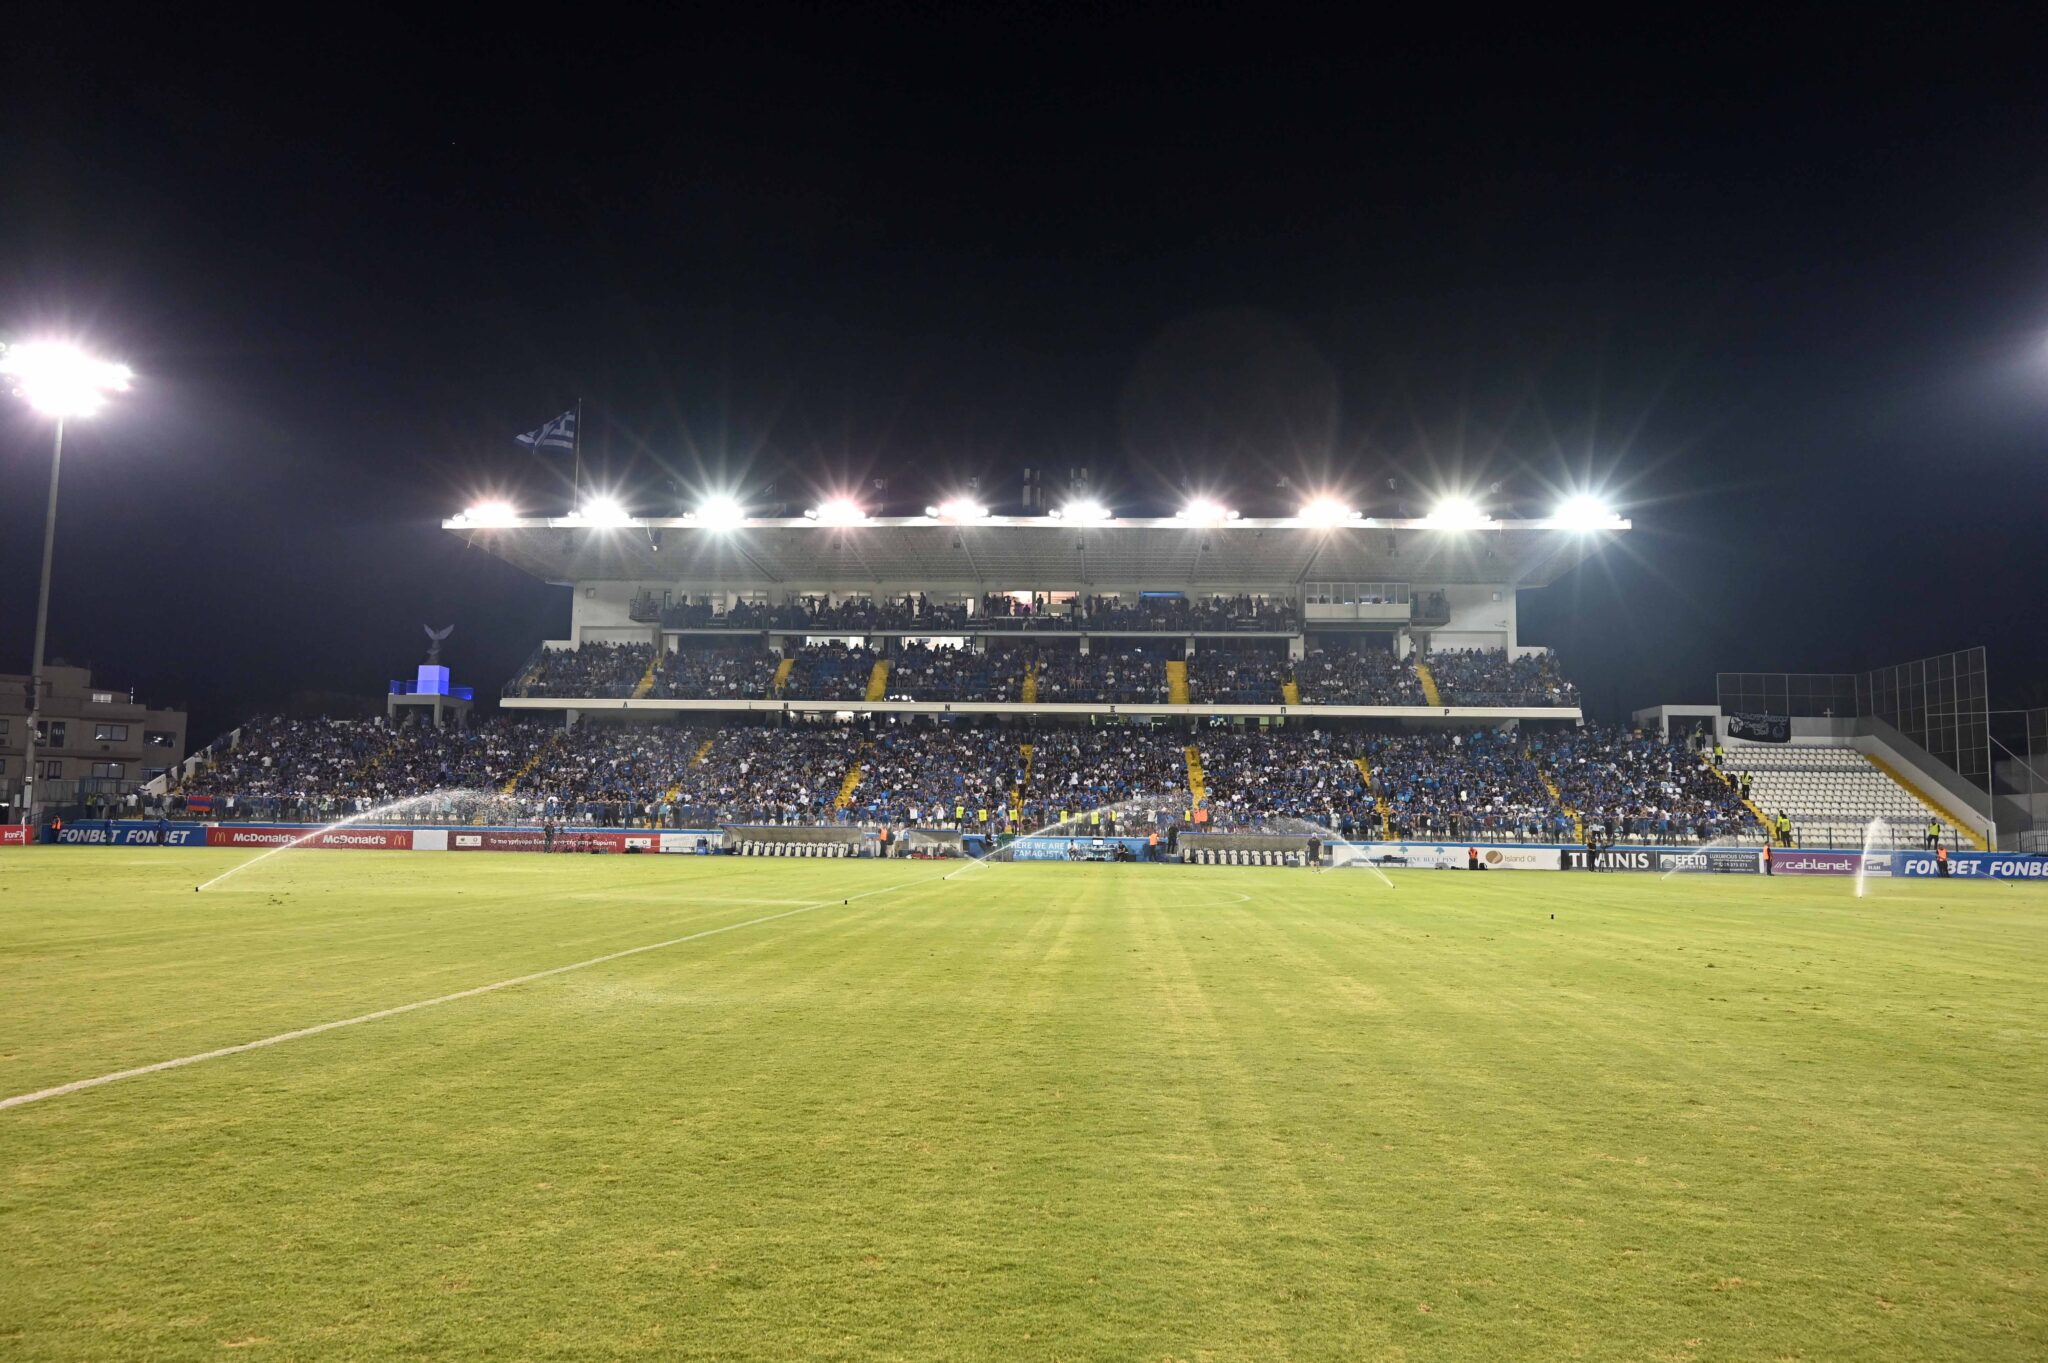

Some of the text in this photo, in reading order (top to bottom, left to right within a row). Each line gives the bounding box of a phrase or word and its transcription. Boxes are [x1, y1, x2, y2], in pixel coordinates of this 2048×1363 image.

[233, 833, 387, 845] McDonald's McDonald's
[1048, 842, 1065, 850] ARE
[1504, 855, 1525, 863] Island
[1675, 854, 1708, 866] EFETO
[1785, 859, 1852, 871] cablenet
[1904, 860, 1981, 875] FONBET
